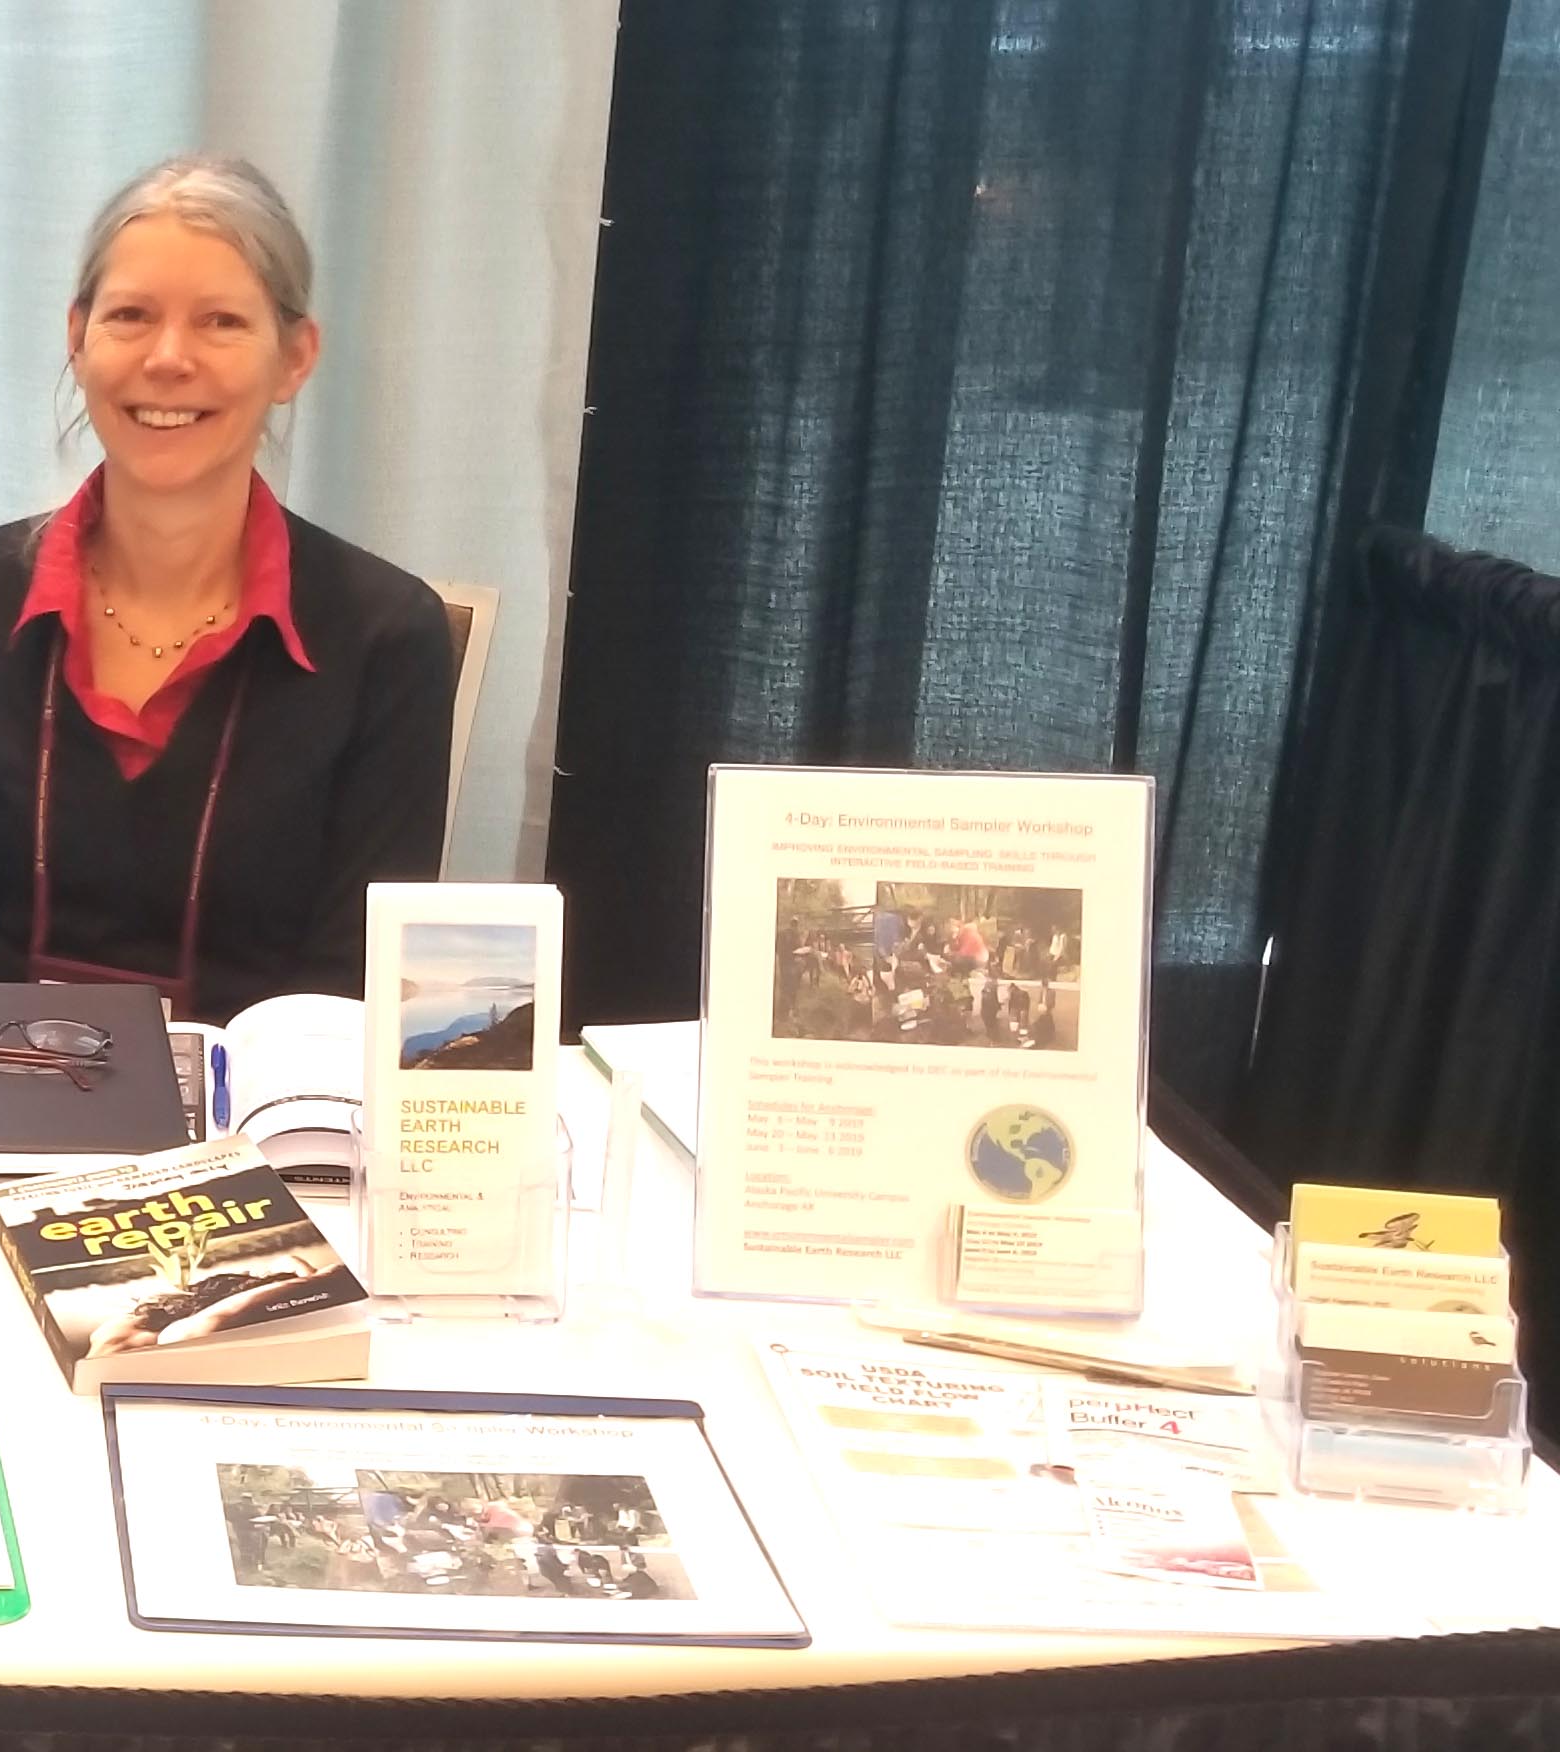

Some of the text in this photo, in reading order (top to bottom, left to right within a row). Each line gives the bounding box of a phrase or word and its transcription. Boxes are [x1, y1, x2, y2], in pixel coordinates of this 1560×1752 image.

[838, 814, 945, 831] Environmental
[950, 817, 1011, 834] Sampler
[1017, 819, 1094, 836] Workshop
[400, 1100, 526, 1115] SUSTAINABLE
[400, 1119, 461, 1133] EARTH
[400, 1140, 500, 1154] RESEARCH
[400, 1159, 433, 1173] LLC
[39, 1192, 217, 1241] earth
[84, 1199, 273, 1256] repair
[800, 1368, 1005, 1392] SOIL TEXTURING
[860, 1363, 927, 1378] USDA
[836, 1382, 979, 1401] FIELD FLOW
[871, 1396, 953, 1409] CHART
[275, 1417, 424, 1433] Environmental
[527, 1425, 635, 1439] Workshop
[1070, 1412, 1182, 1436] Buffer 4
